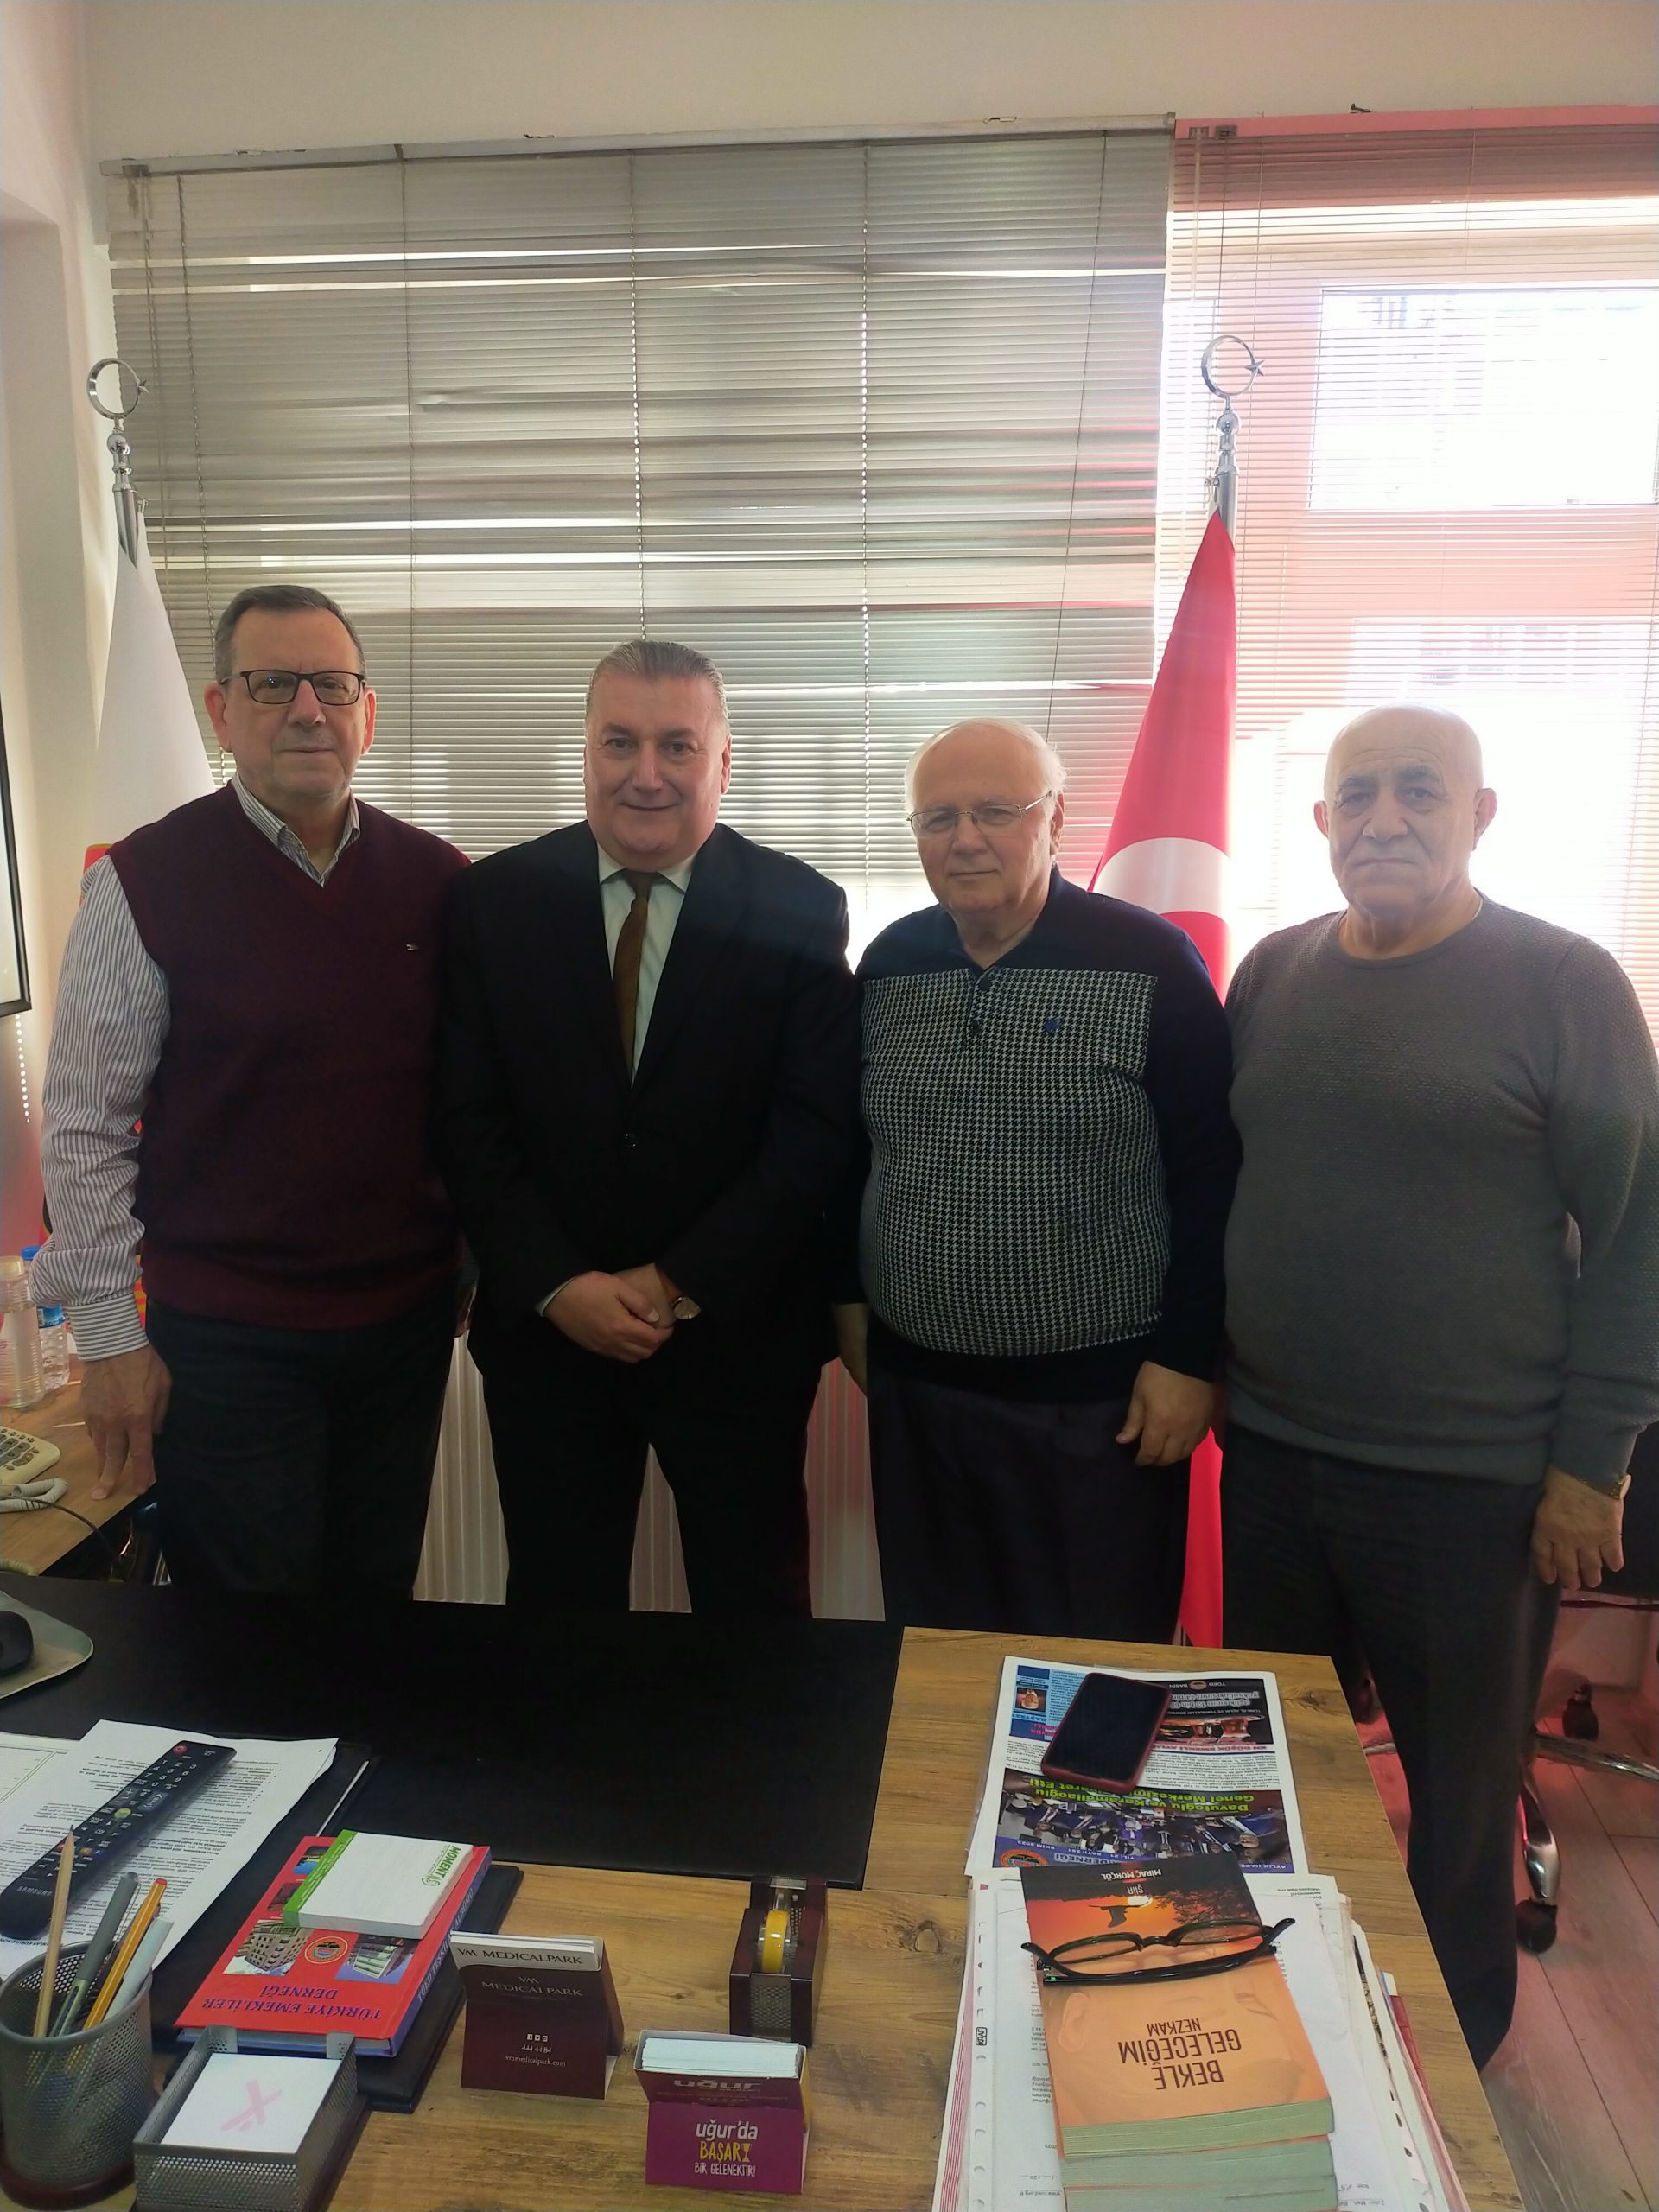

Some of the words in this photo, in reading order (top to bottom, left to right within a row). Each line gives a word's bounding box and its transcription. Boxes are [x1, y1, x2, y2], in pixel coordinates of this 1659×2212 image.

[1029, 1777, 1055, 1789] Etti
[1035, 1789, 1146, 1807] Karamollaoğlu
[1211, 1795, 1254, 1803] Genel
[1171, 1803, 1249, 1812] Davutoğlu
[435, 1845, 462, 1879] MOMENT
[1101, 1872, 1135, 1882] MORÇÖL
[1135, 1868, 1161, 1880] MİRAÇ
[1127, 1884, 1144, 1895] ŞİİR
[483, 1950, 584, 1965] MEDICALPARK
[259, 1985, 340, 2000] DERNEĞİ
[481, 1980, 584, 1997] MEDICALPARK
[200, 1998, 302, 2014] EMEKLİLER
[304, 2003, 384, 2020] TÜRKİYE
[1147, 2018, 1202, 2037] NEZKAM
[976, 2028, 986, 2045] KRAF
[1117, 2028, 1242, 2066] GELECEĞİM
[505, 2055, 566, 2068] vmmedicalpark.com
[1151, 2059, 1224, 2090] BEKLE
[673, 2077, 764, 2090] uğur
[696, 2118, 759, 2142] uğur'da
